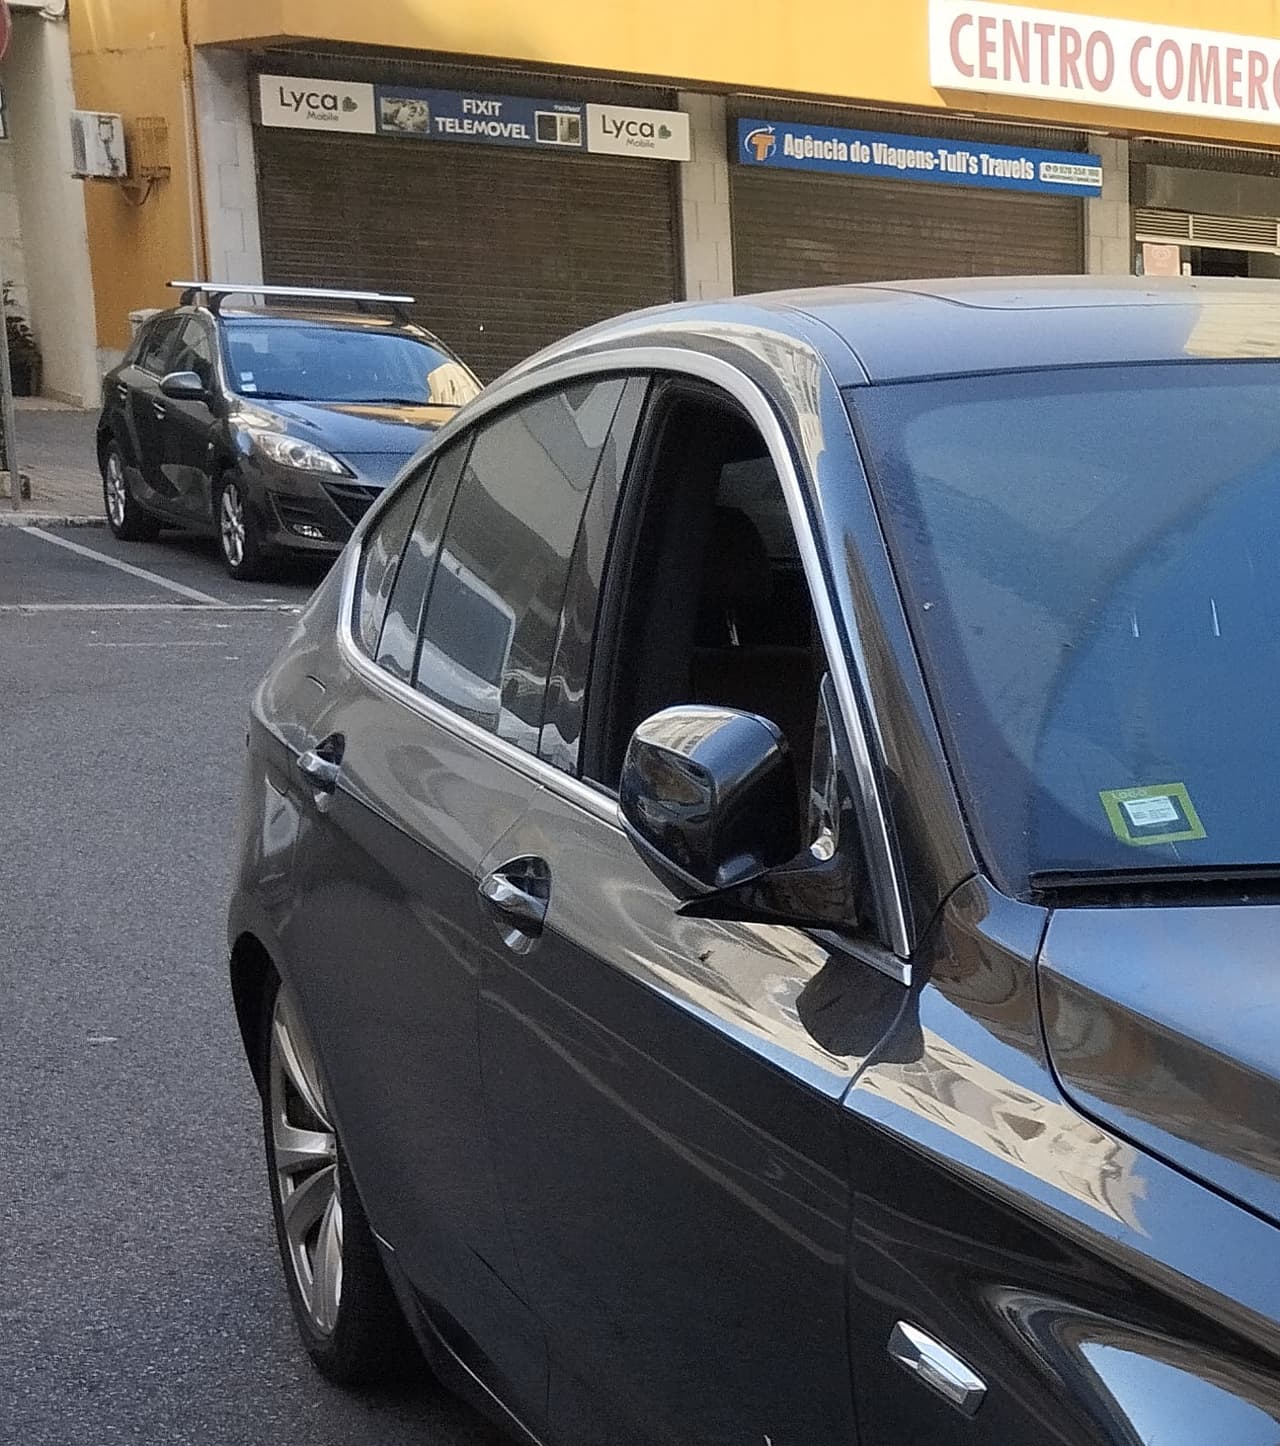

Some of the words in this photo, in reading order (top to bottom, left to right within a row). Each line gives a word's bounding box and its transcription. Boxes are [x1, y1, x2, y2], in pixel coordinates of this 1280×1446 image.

[949, 13, 1115, 93] CENTRO
[279, 86, 338, 112] Lyca
[462, 99, 502, 117] FIXIT
[306, 111, 339, 122] Mobile
[435, 117, 530, 139] TELEMOVEL
[602, 114, 655, 138] Lyca
[626, 138, 655, 149] Mobile
[784, 134, 848, 161] Agência
[850, 139, 871, 163] de
[980, 153, 1034, 180] Travels
